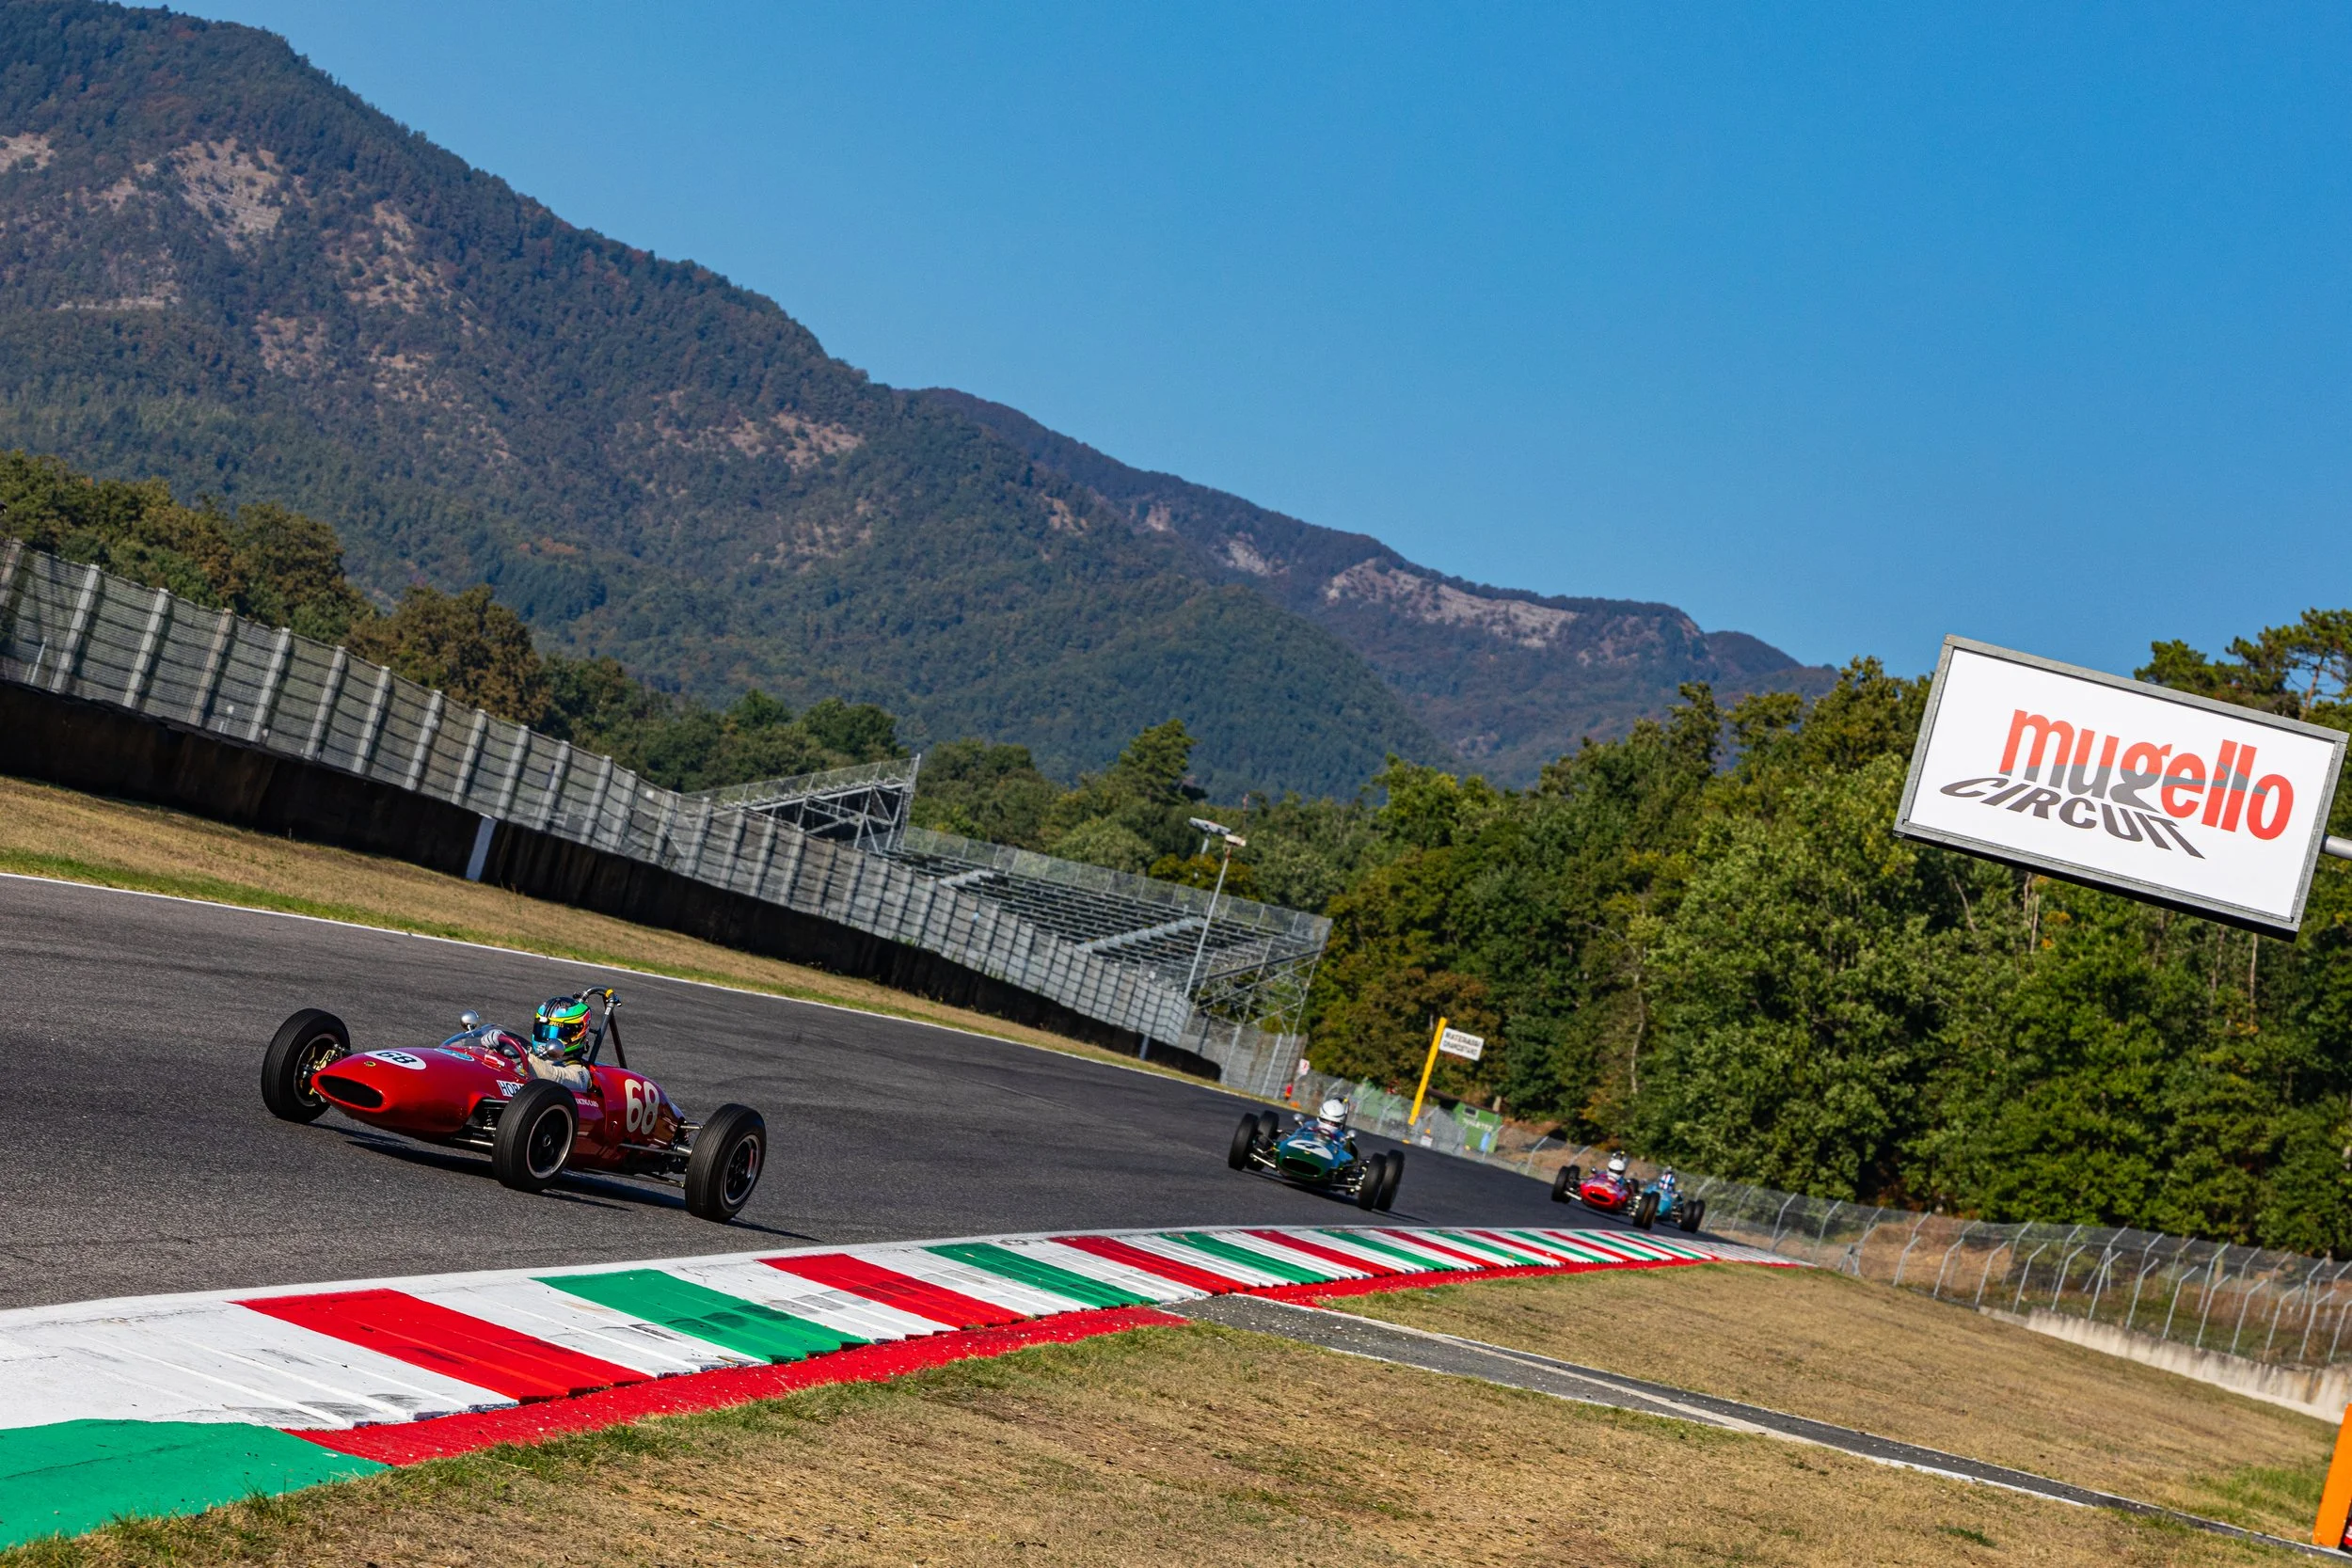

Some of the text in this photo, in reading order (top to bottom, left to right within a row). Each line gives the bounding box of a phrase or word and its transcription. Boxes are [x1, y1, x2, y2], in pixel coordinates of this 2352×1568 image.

[1998, 708, 2294, 841] mugello
[1940, 777, 2206, 860] CIRCUIT
[375, 1052, 417, 1064] 68
[625, 1078, 660, 1135] 68
